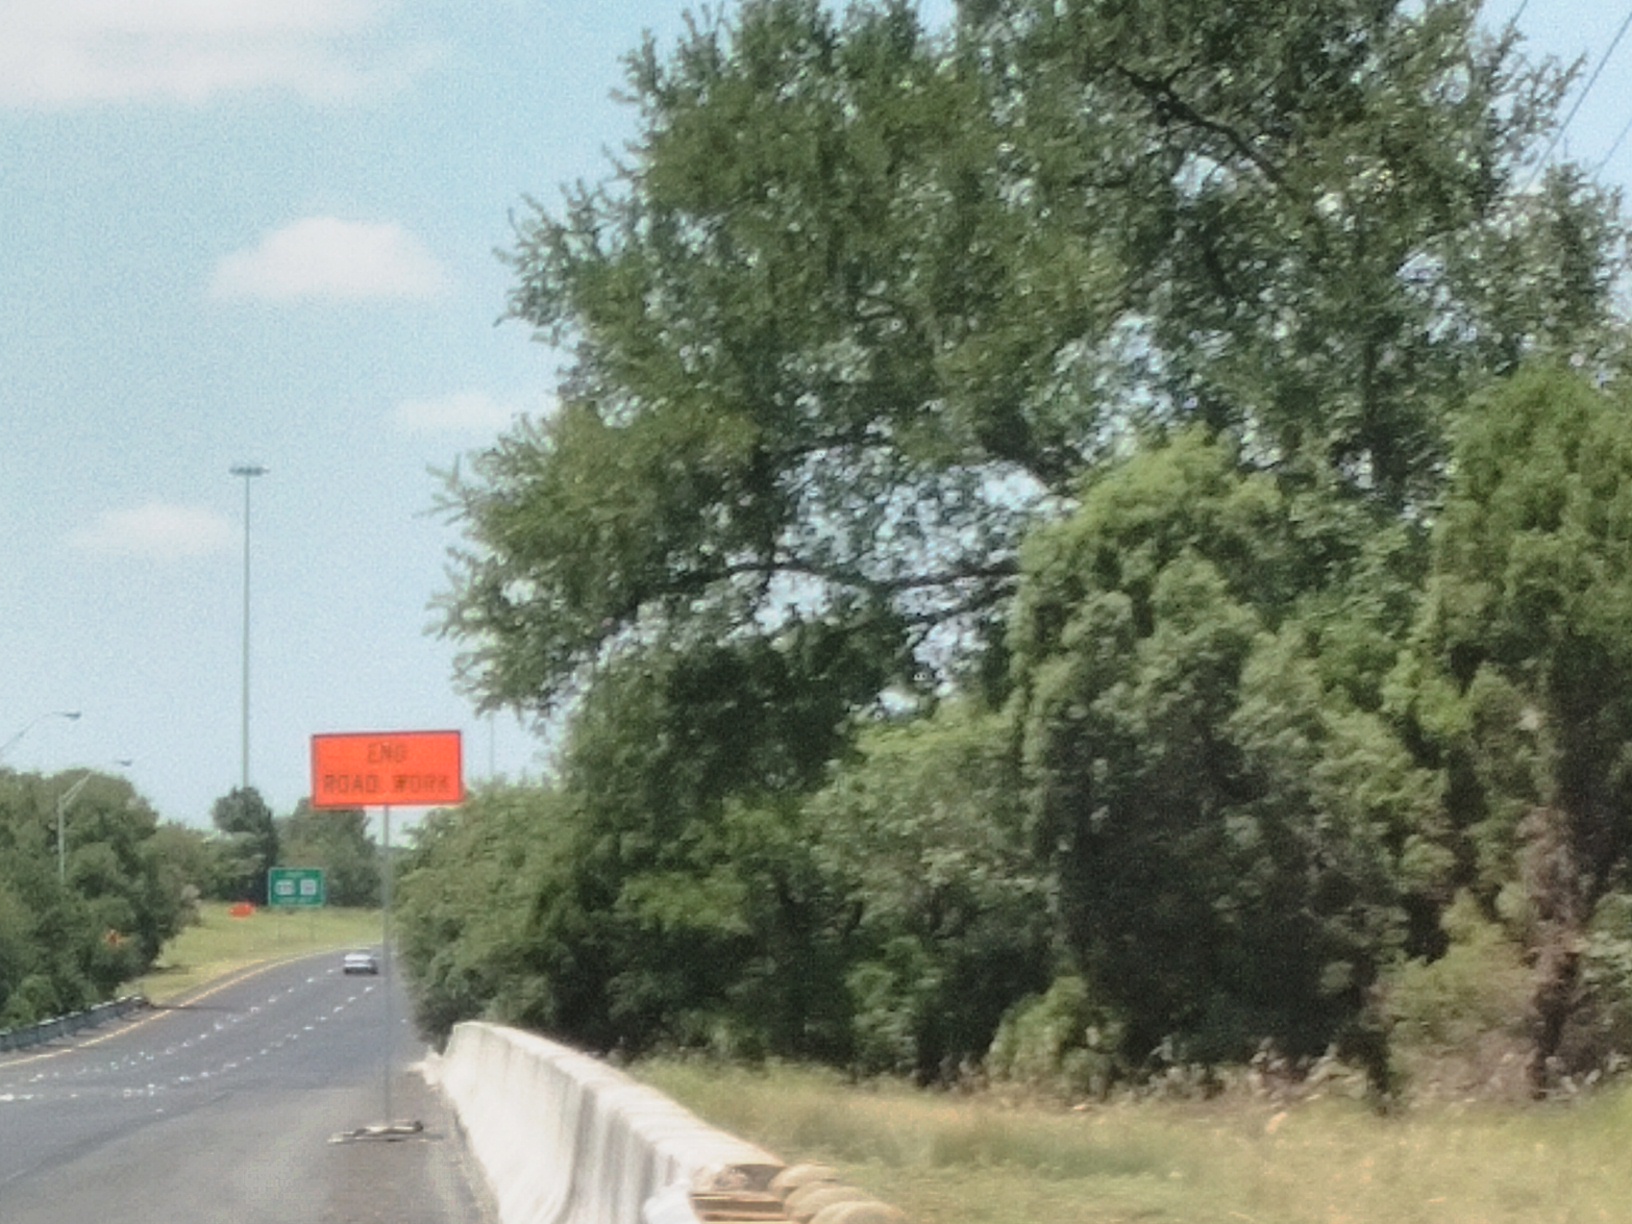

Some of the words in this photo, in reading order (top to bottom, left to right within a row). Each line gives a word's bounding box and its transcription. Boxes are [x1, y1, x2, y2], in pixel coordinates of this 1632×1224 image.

[367, 742, 407, 764] END
[323, 774, 380, 794] ROAD
[392, 774, 450, 793] WORK
